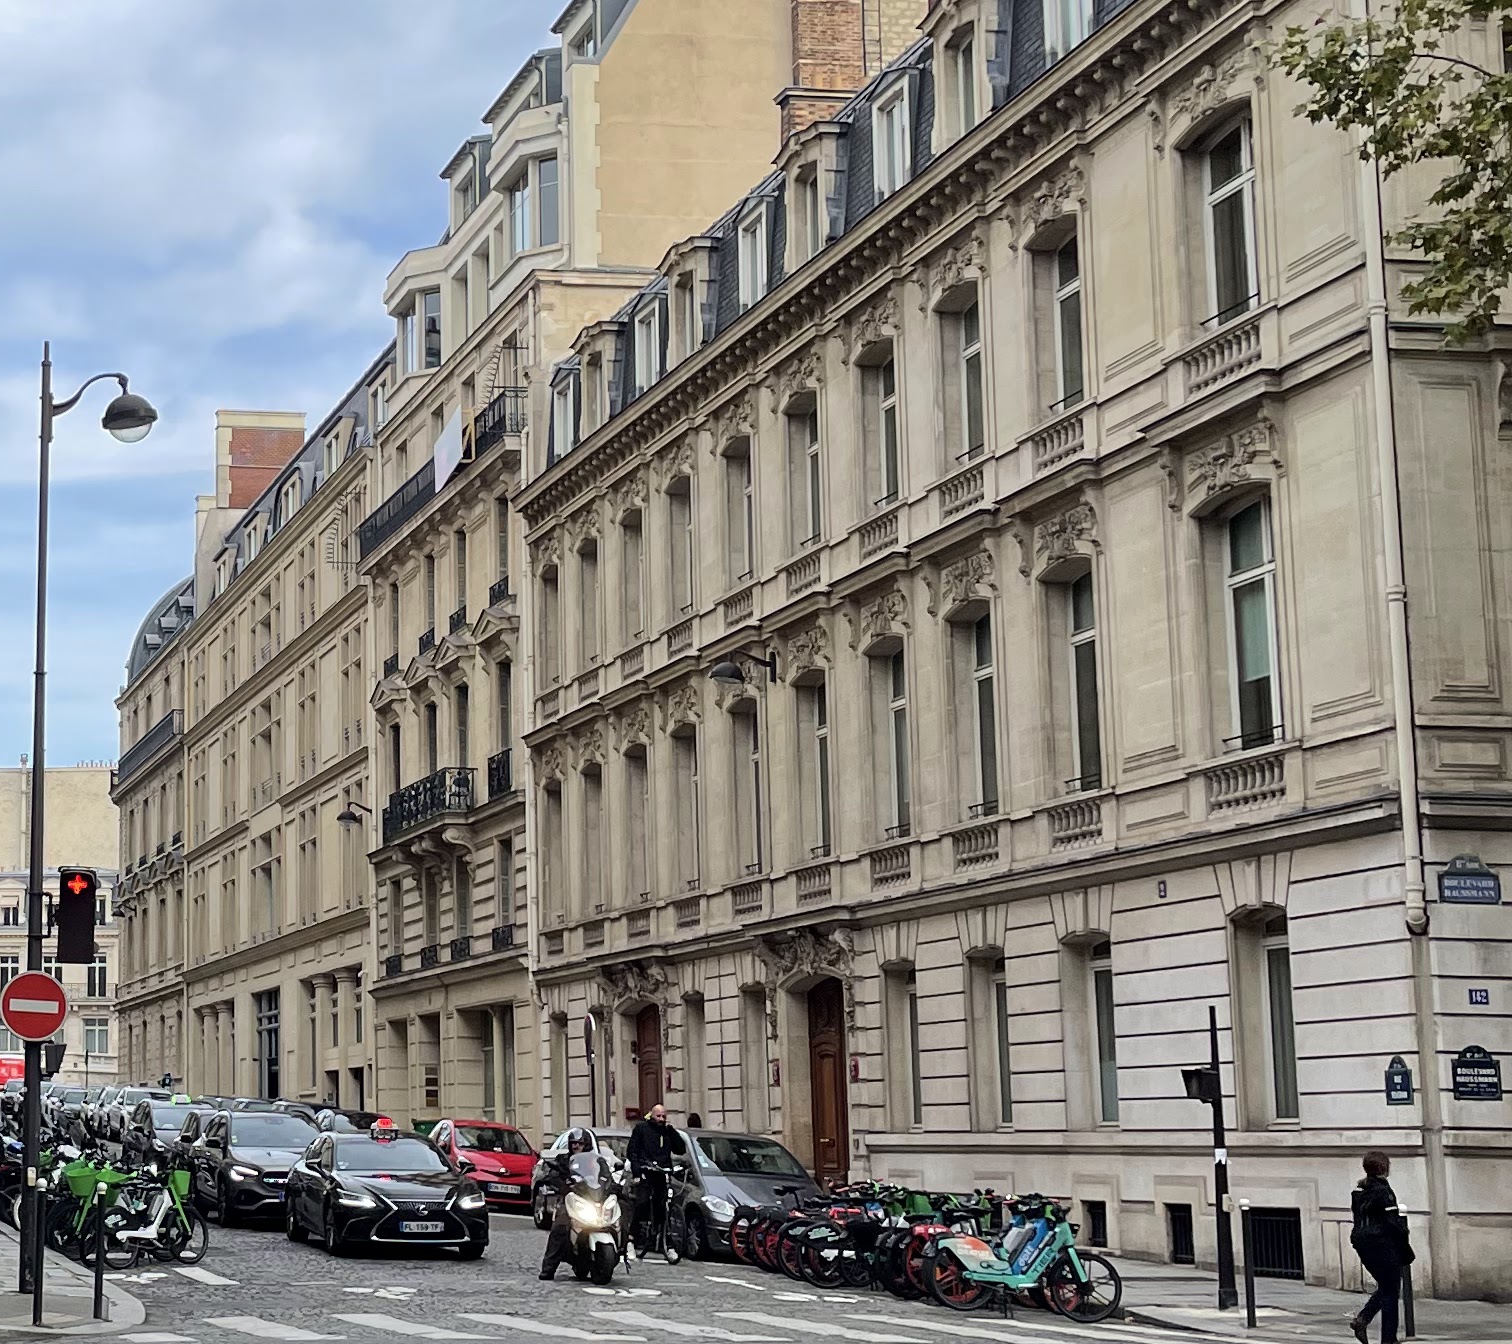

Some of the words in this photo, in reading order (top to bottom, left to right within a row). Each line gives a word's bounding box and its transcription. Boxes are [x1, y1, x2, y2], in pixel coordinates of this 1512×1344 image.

[1444, 879, 1495, 888] BOULEVARD
[1444, 888, 1496, 898] HAUSSMANN
[1471, 991, 1488, 1003] 142
[1456, 1067, 1496, 1076] BOULEVARD
